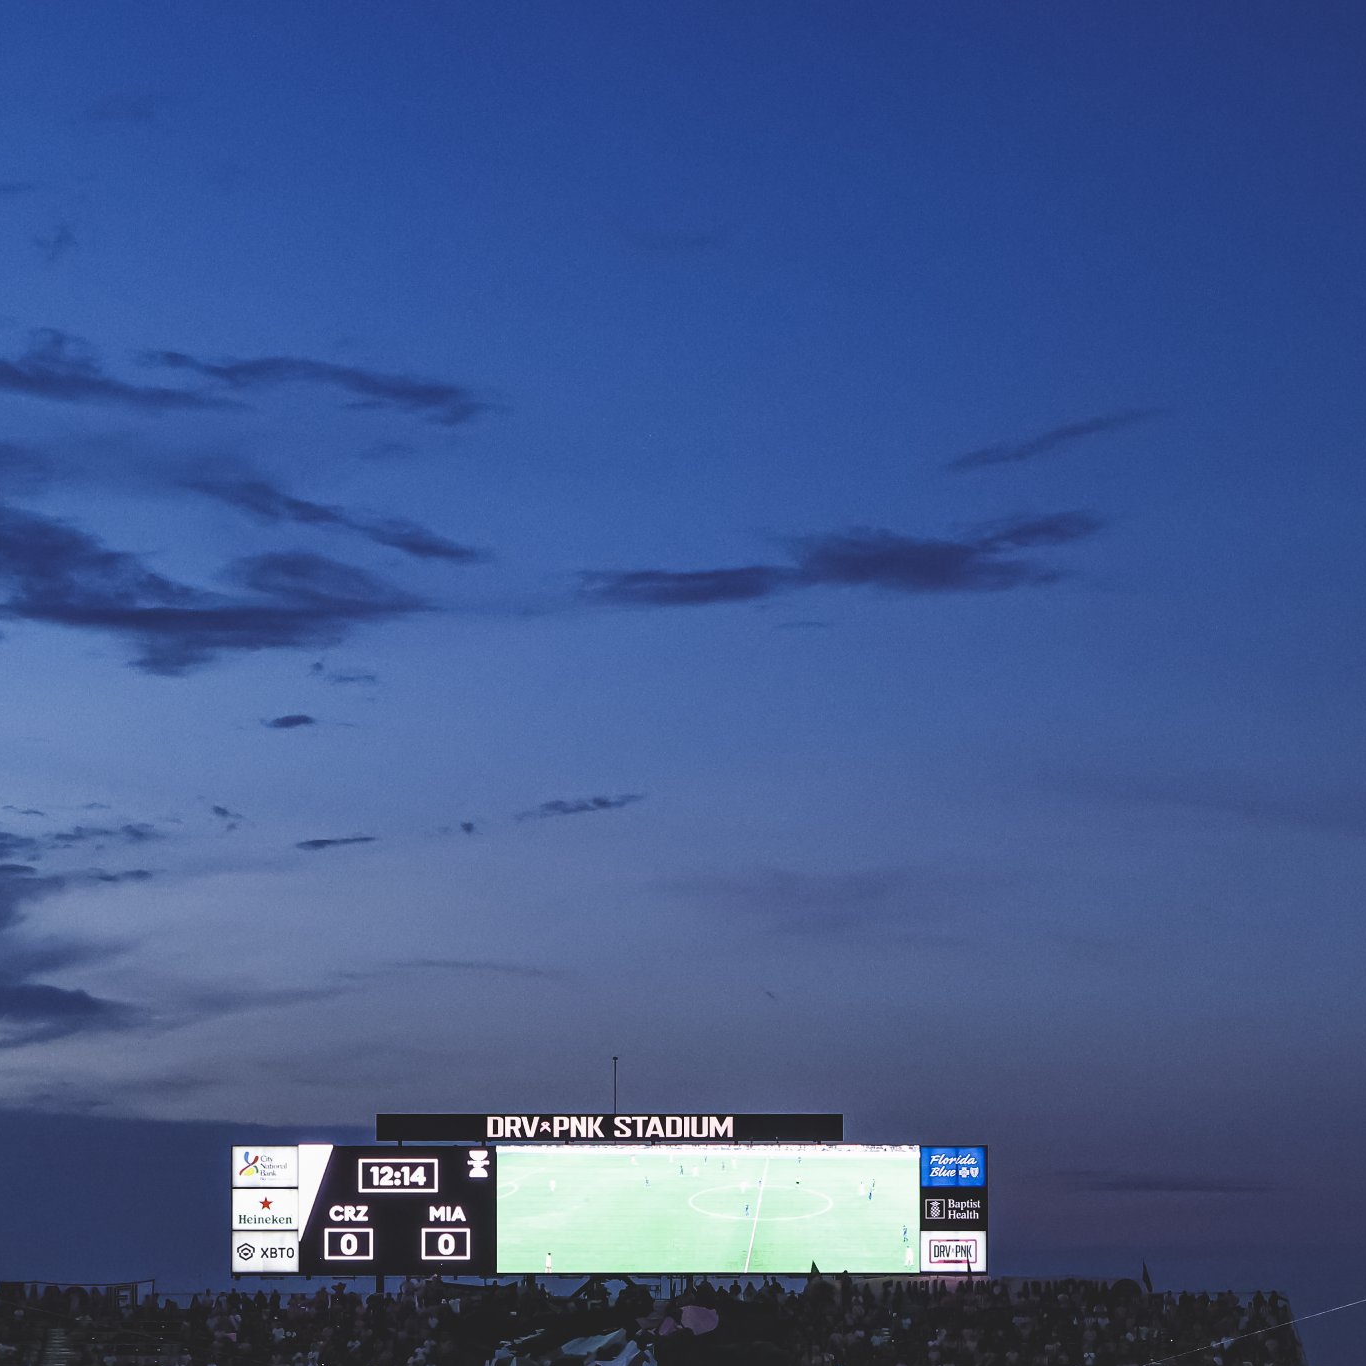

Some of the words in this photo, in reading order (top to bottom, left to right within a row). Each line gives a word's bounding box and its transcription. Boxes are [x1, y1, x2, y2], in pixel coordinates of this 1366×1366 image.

[613, 1116, 734, 1138] STADIUM
[929, 1154, 978, 1165] Florida
[369, 1165, 427, 1187] 12:14
[929, 1167, 957, 1177] Blue
[947, 1199, 981, 1211] Baptist
[238, 1214, 293, 1225] Heineken
[328, 1205, 370, 1222] CRZ
[428, 1205, 467, 1222] MIA
[947, 1209, 980, 1220] Health
[339, 1233, 358, 1256] 0
[437, 1233, 456, 1256] 0
[260, 1247, 295, 1259] XBTO
